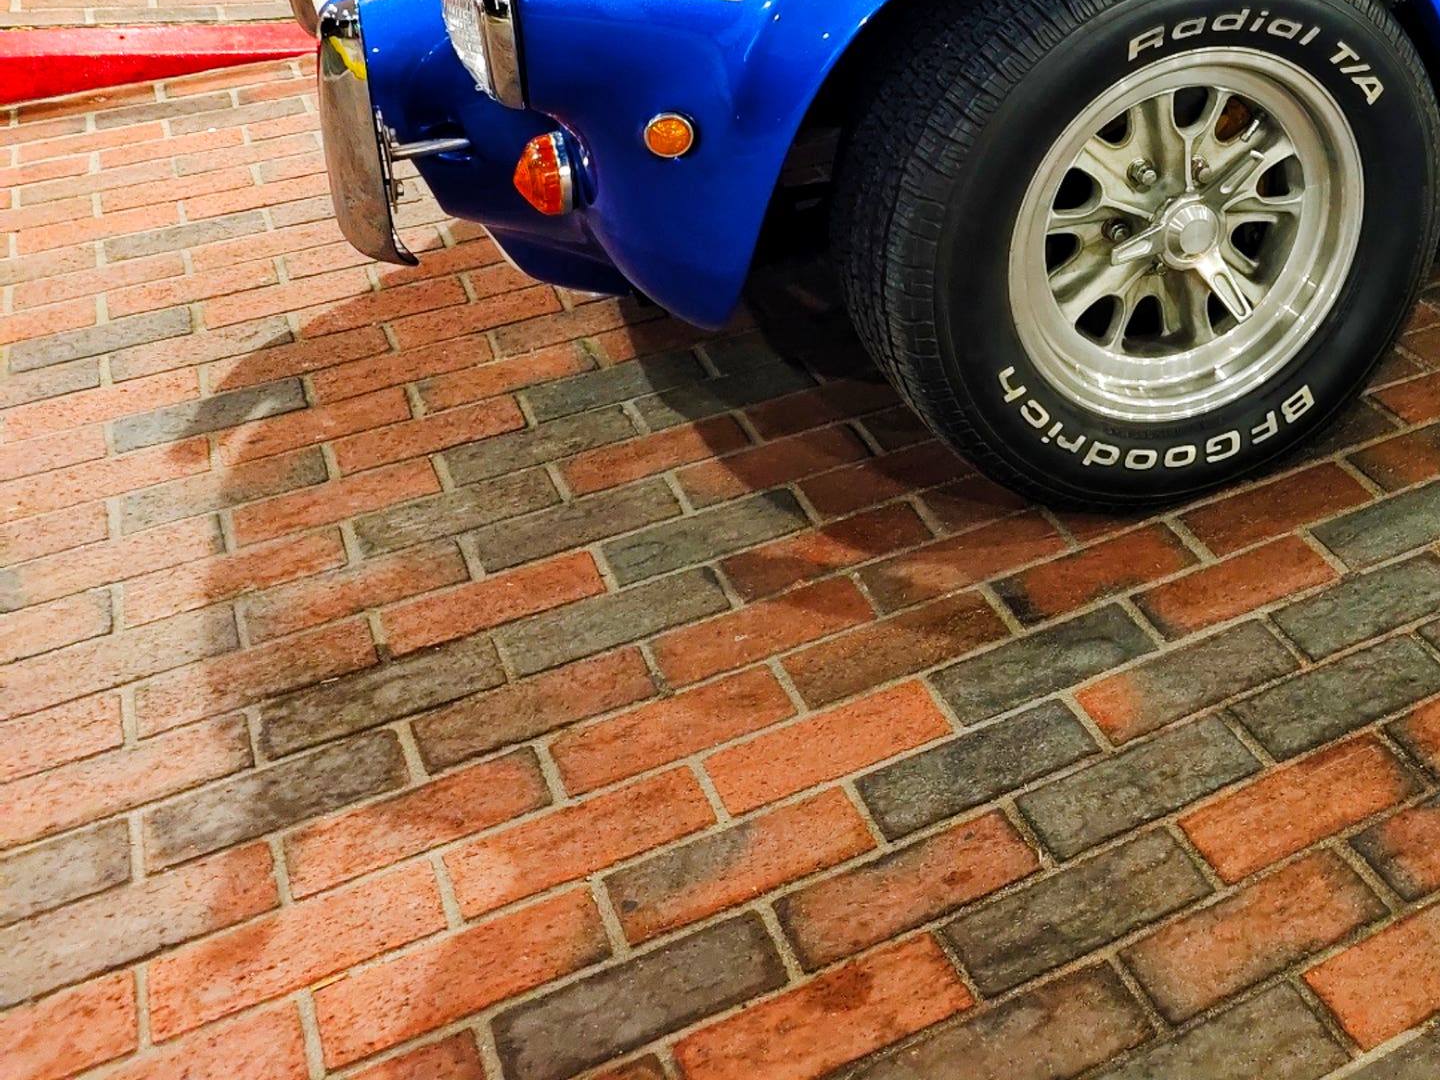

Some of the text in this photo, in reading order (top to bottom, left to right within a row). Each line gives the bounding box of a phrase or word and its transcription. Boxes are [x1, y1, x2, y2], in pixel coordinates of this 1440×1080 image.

[1127, 7, 1386, 106] Radial T/A
[997, 365, 1316, 471] BFGoodrich
